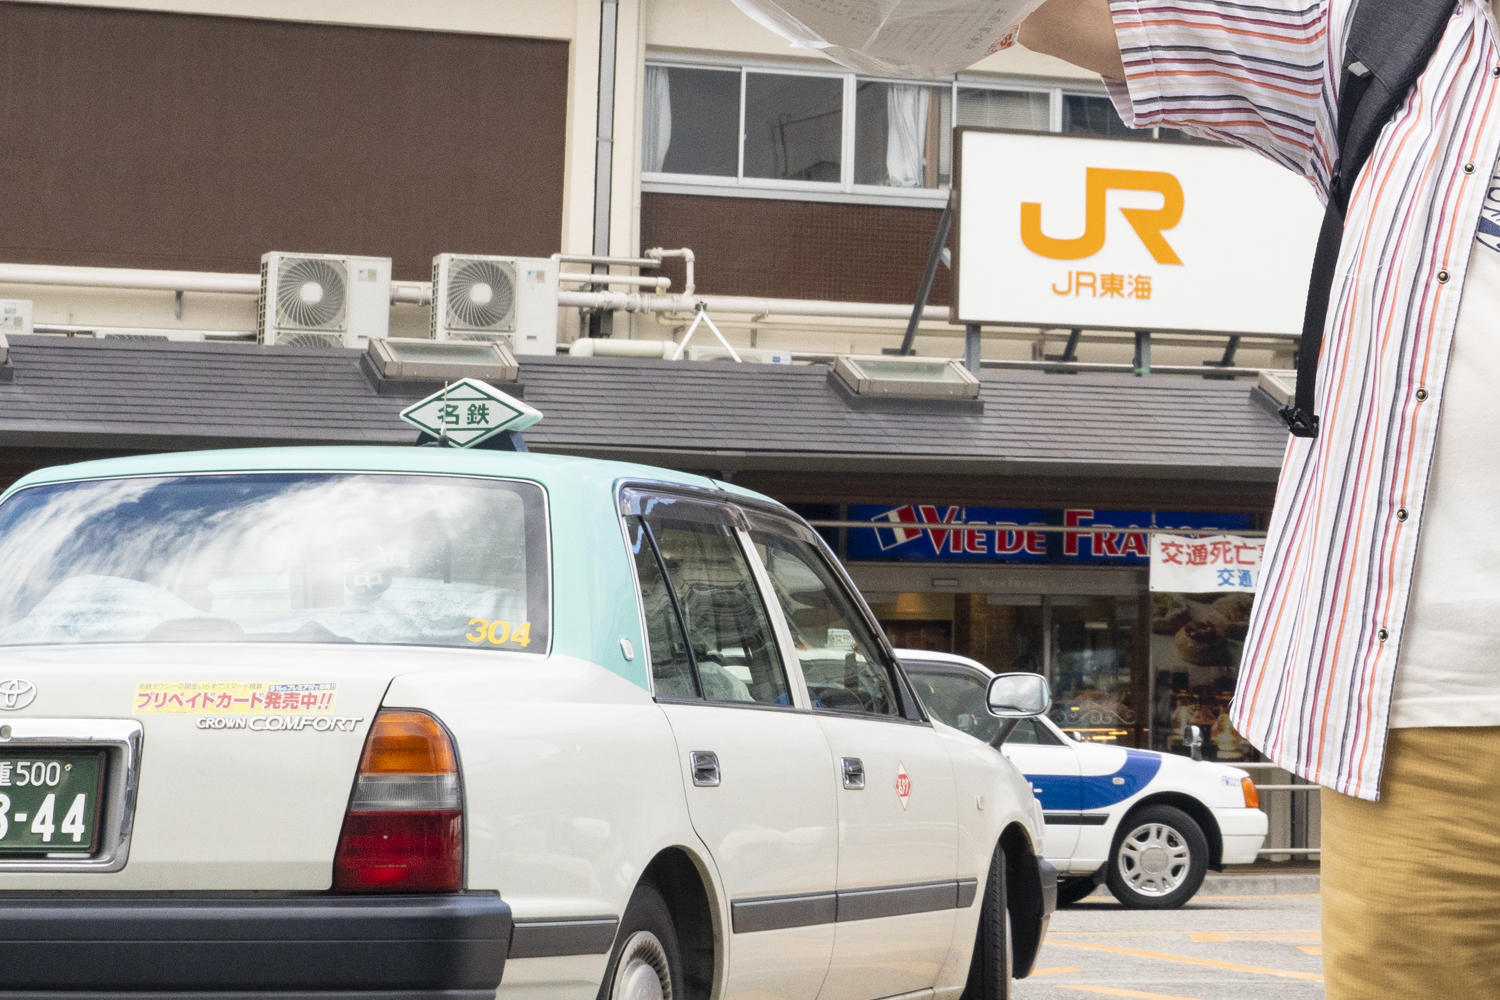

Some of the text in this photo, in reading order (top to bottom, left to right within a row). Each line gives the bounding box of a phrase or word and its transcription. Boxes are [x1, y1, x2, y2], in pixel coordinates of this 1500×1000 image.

[1020, 167, 1185, 266] JR
[1052, 271, 1152, 300] JR東海
[437, 403, 490, 425] 名鉄
[917, 505, 1218, 557] VIE DE FRA
[466, 618, 531, 647] 304
[196, 716, 364, 732] CROWN COMFORT
